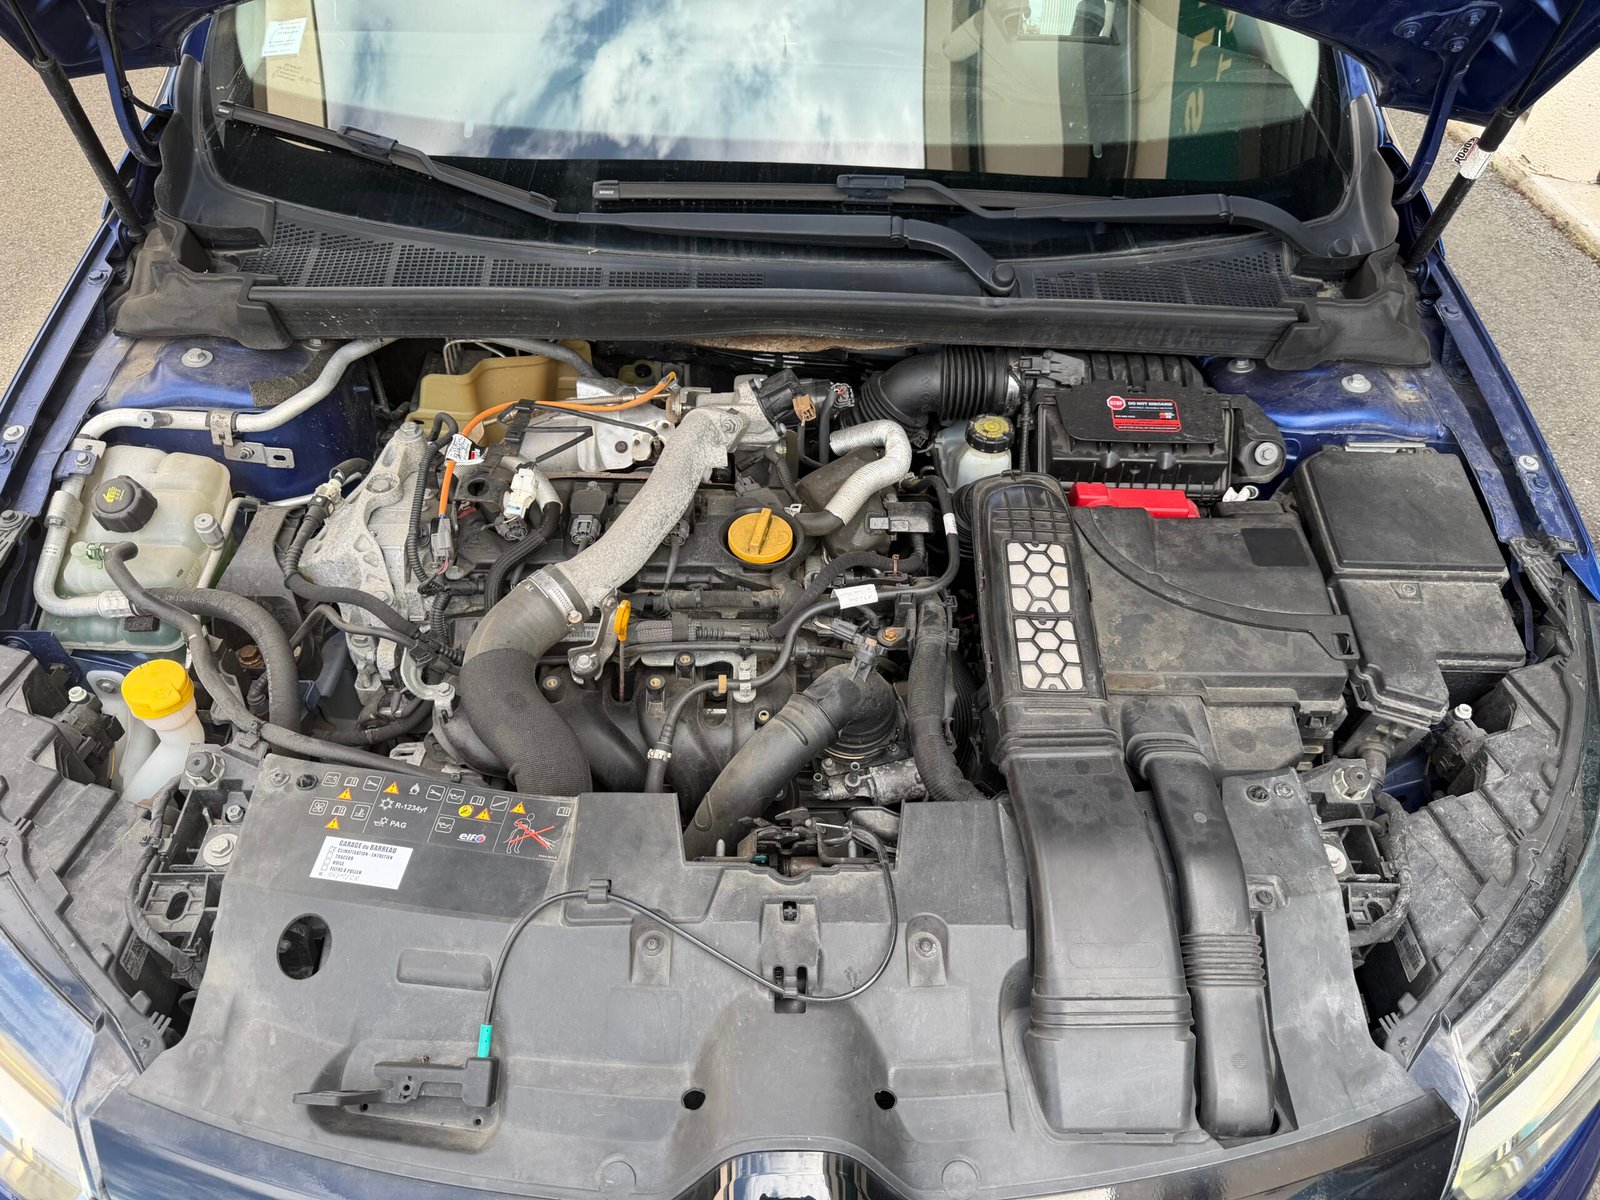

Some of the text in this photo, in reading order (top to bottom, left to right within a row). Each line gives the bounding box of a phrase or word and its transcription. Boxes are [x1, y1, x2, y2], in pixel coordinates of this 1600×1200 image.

[394, 803, 428, 814] R-1234yf
[389, 820, 407, 829] PAG
[458, 832, 477, 842] elf
[338, 839, 363, 850] GARAGE
[369, 843, 398, 854] BARREAU
